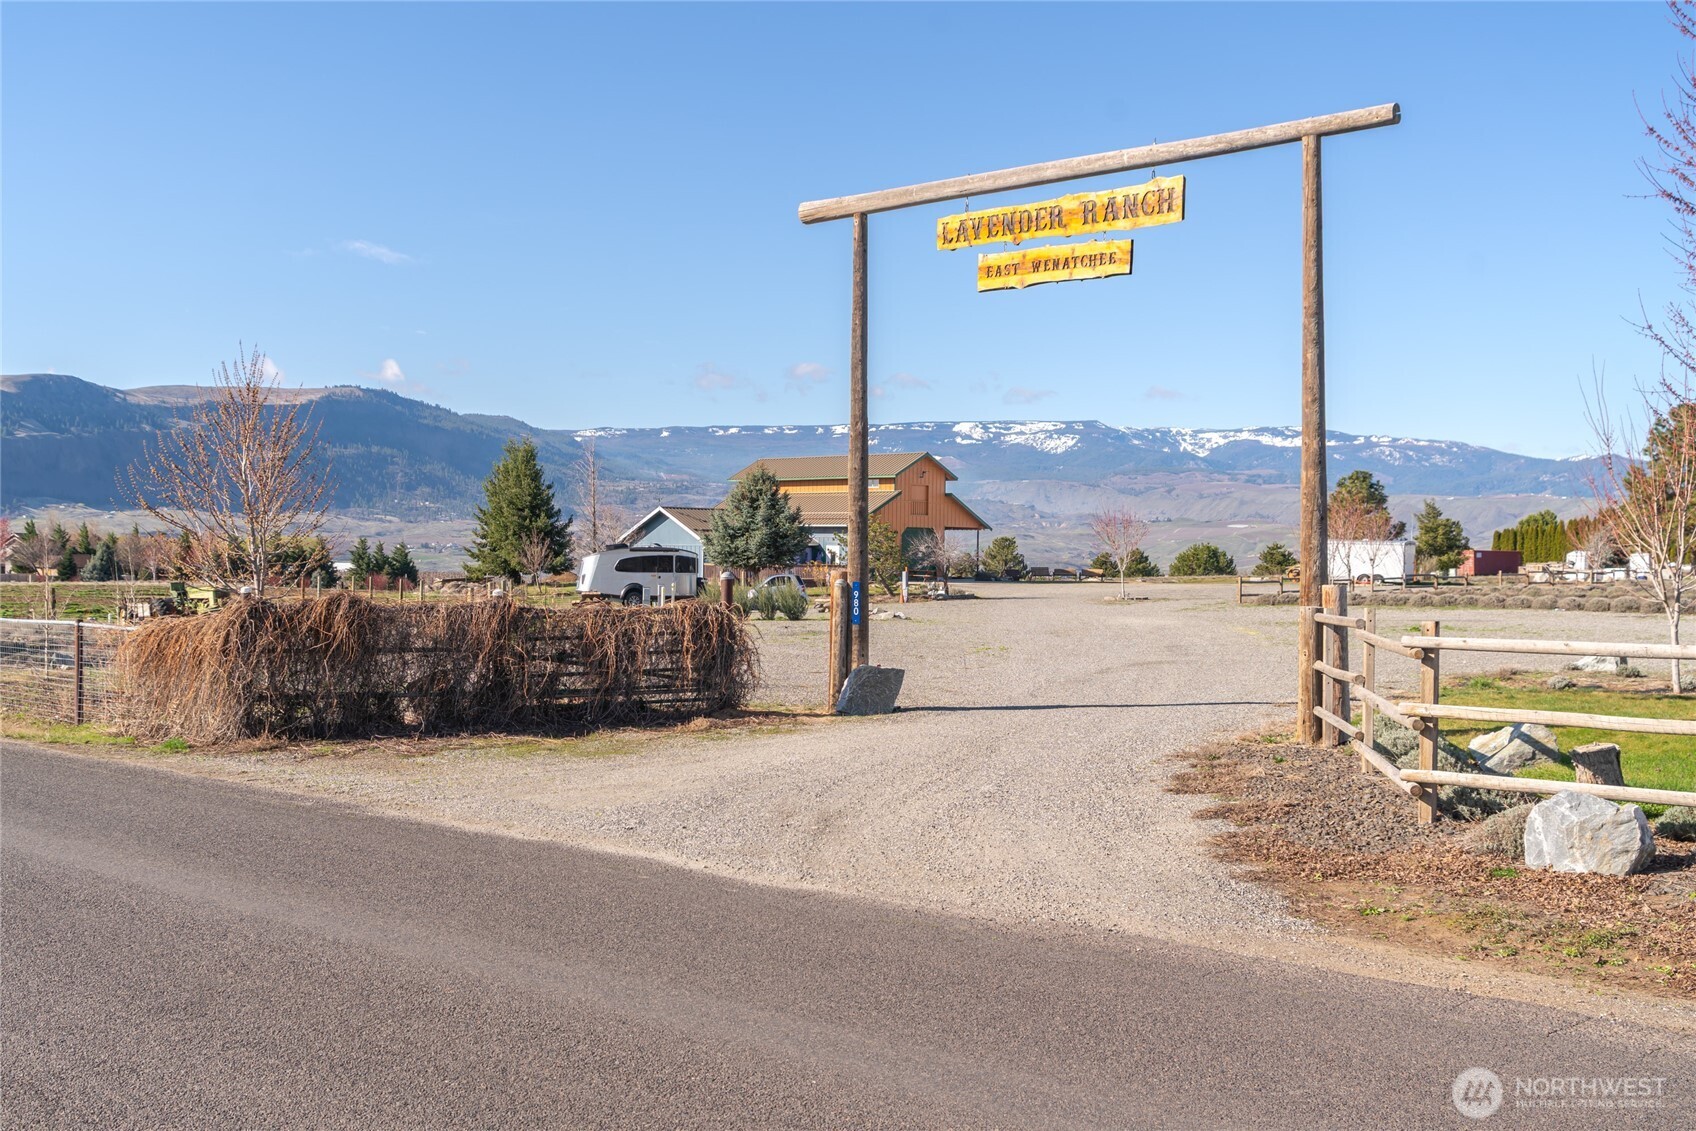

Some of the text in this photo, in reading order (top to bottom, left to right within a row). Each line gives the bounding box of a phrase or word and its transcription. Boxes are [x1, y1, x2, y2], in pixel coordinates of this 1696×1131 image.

[941, 187, 1176, 245] LAVENDER RANCH
[986, 251, 1117, 279] EAST WENATCHEE
